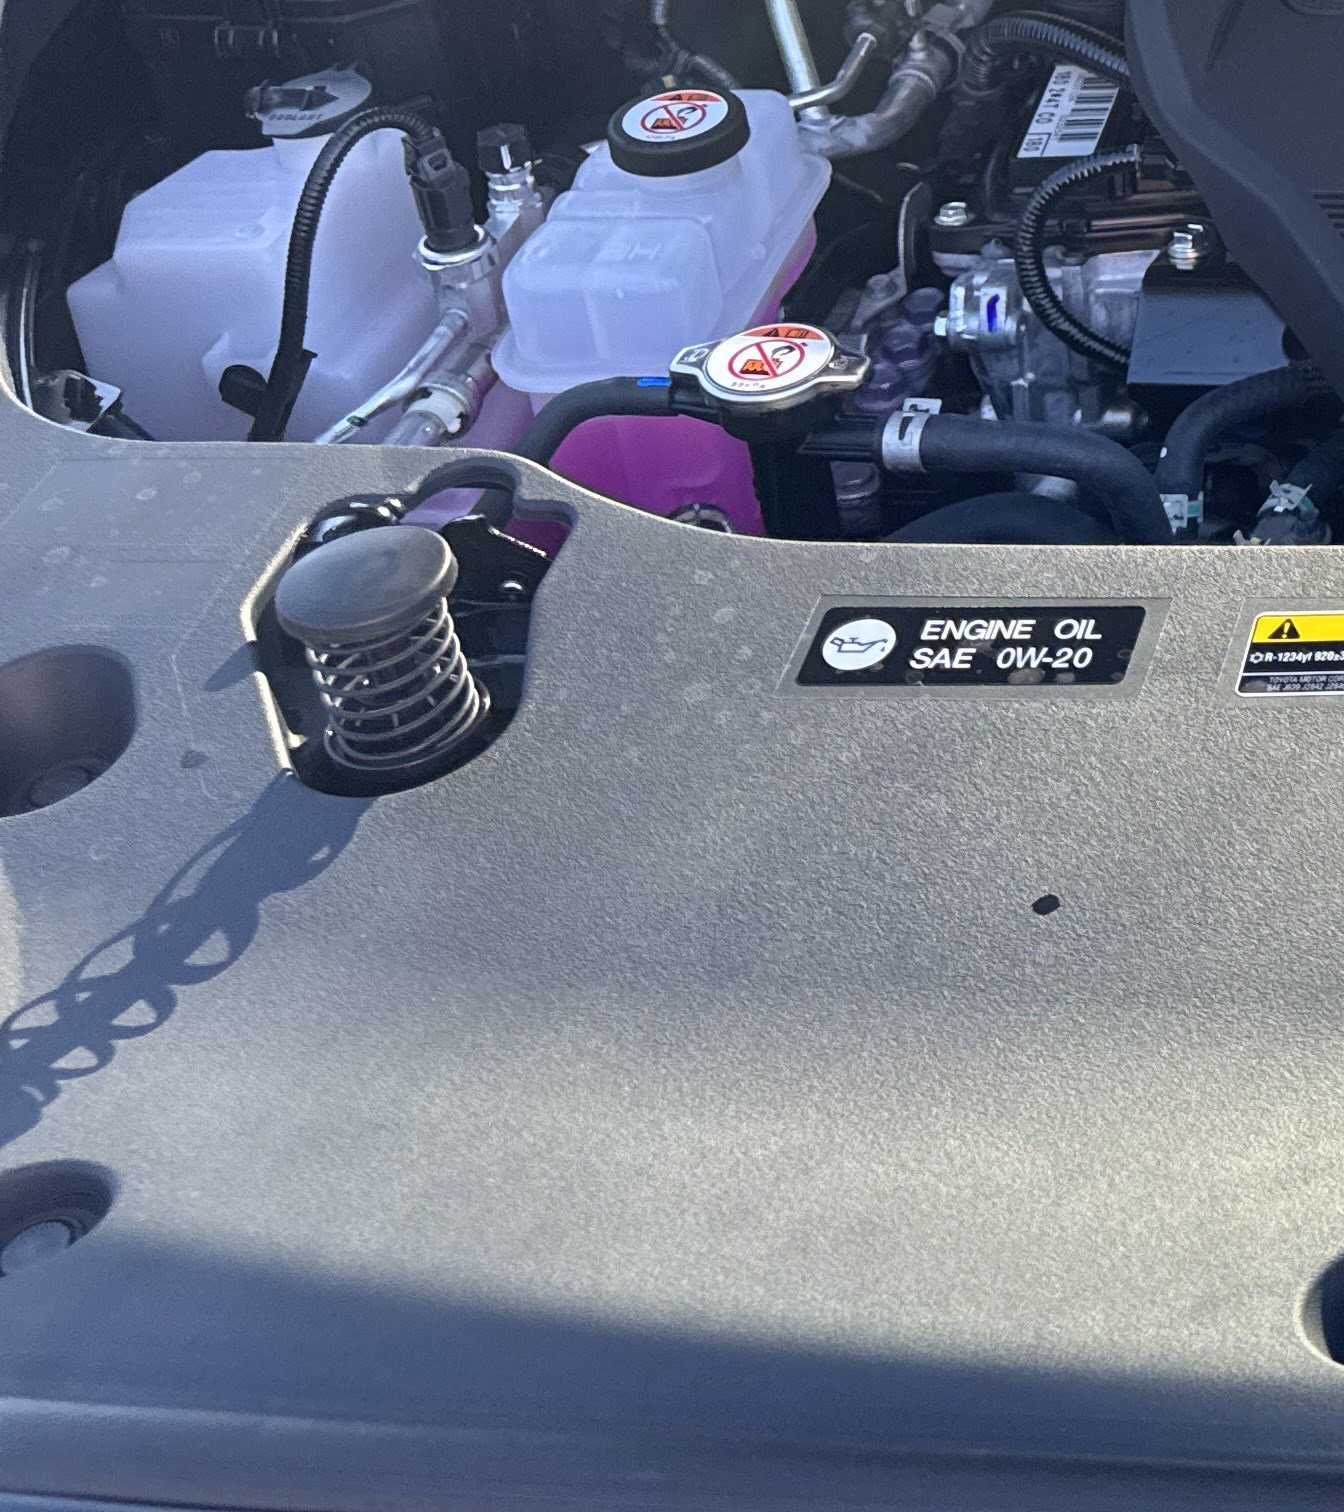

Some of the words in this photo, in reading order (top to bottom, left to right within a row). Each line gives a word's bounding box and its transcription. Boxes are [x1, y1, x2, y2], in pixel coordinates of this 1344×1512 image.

[920, 619, 1036, 640] ENGINE
[1053, 619, 1102, 640] OIL
[909, 647, 977, 669] SAE
[996, 647, 1093, 669] 0W-20
[1264, 651, 1313, 664] R-1234yf
[1269, 675, 1298, 683] TOYOTA
[1299, 675, 1327, 683] MOTOR
